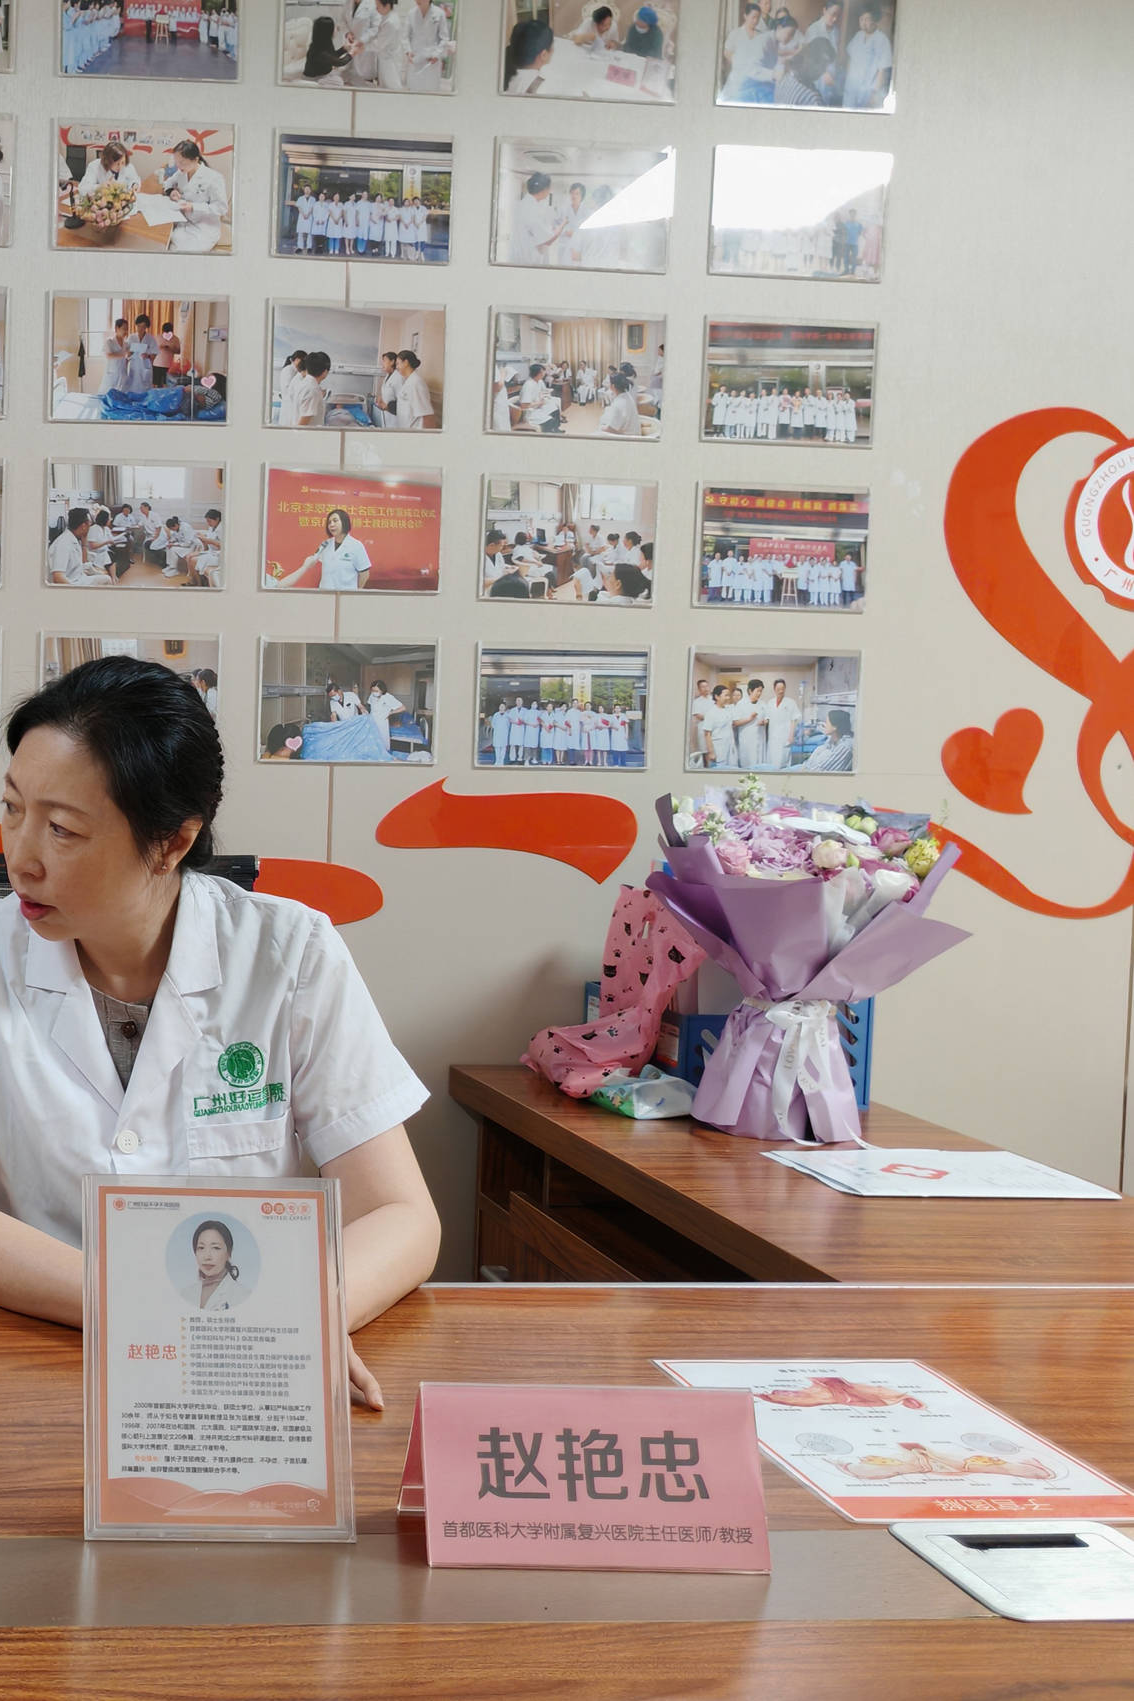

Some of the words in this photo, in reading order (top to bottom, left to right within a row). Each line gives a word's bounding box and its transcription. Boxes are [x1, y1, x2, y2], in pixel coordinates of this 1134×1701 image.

[127, 1343, 178, 1361] 赵艳忠
[476, 1427, 710, 1502] 赵艳忠
[442, 1520, 753, 1545] 首都医科大学附属复兴医院主任医师/教授
